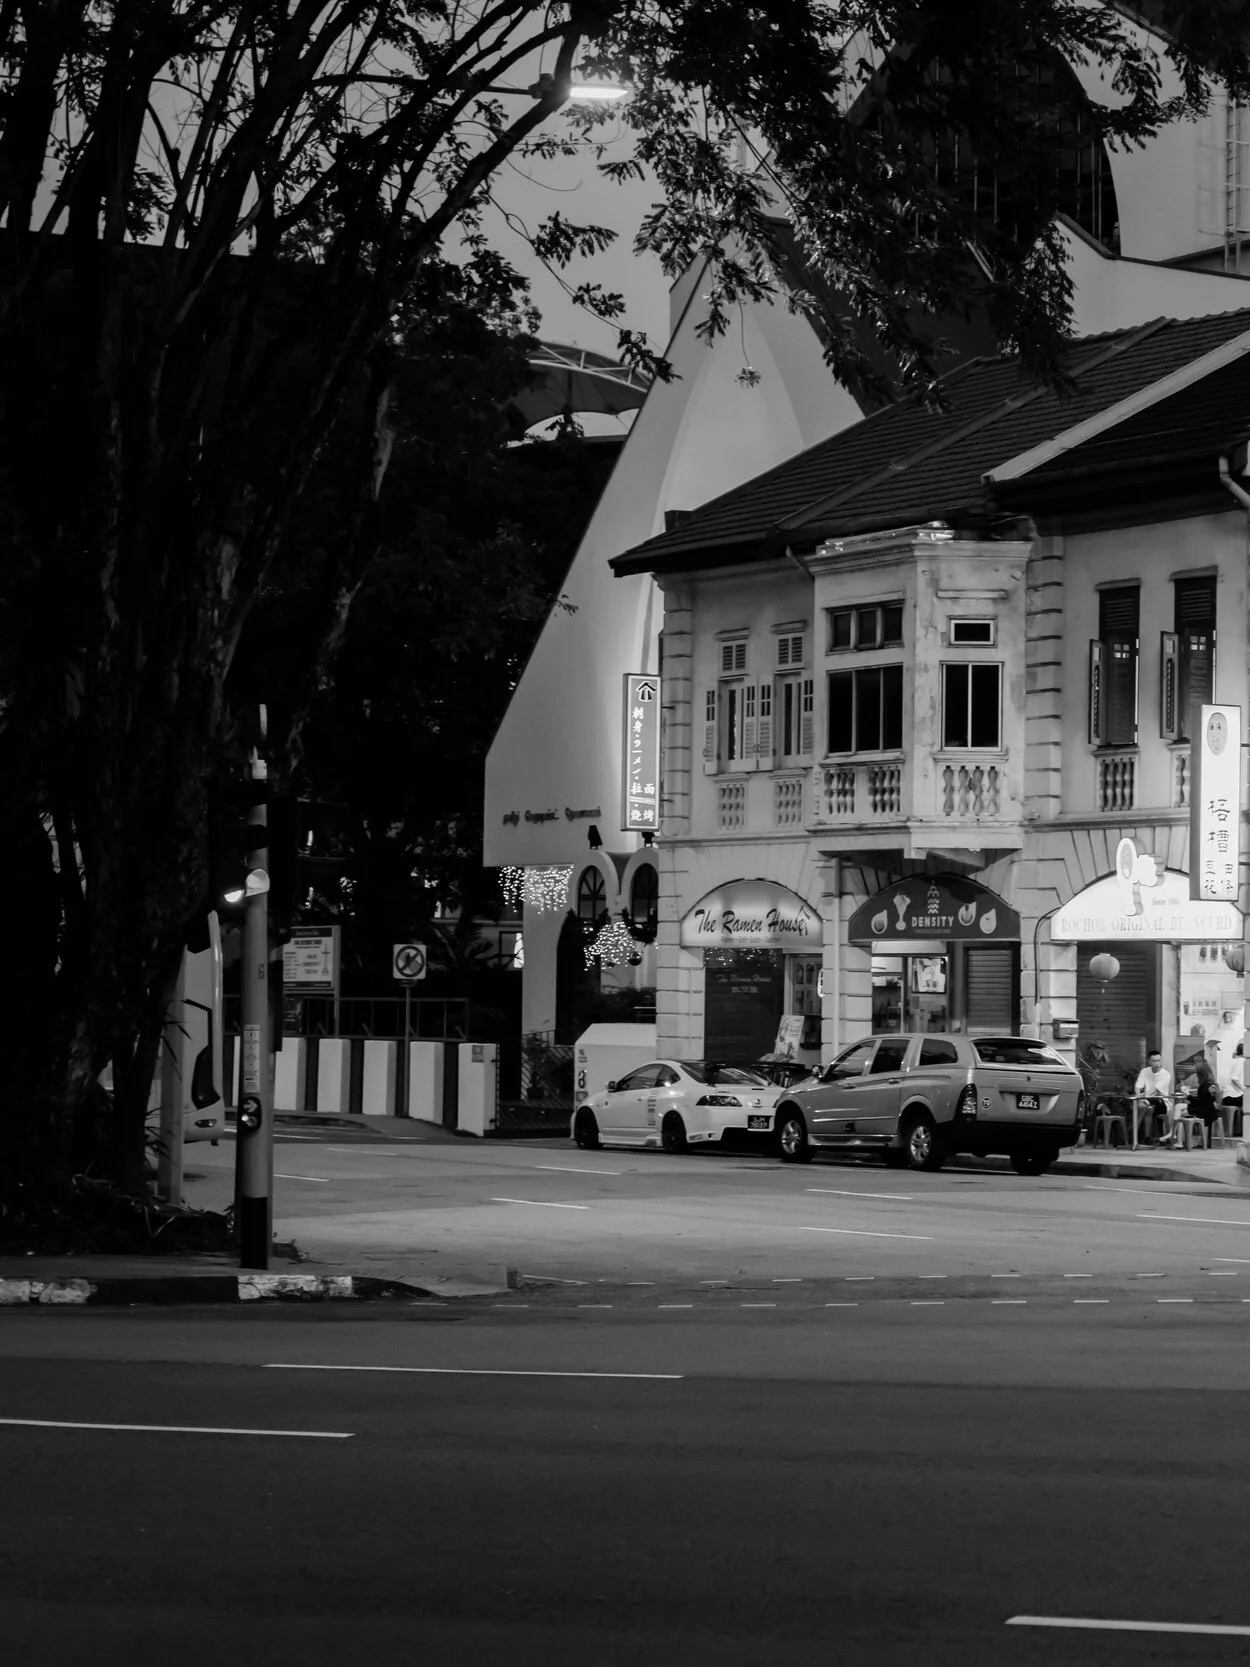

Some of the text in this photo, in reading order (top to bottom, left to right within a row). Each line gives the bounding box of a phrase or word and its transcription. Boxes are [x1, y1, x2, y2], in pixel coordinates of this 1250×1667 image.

[694, 908, 805, 935] The Ramen House
[911, 915, 955, 928] DENSITY
[1171, 916, 1232, 931] BENCURD
